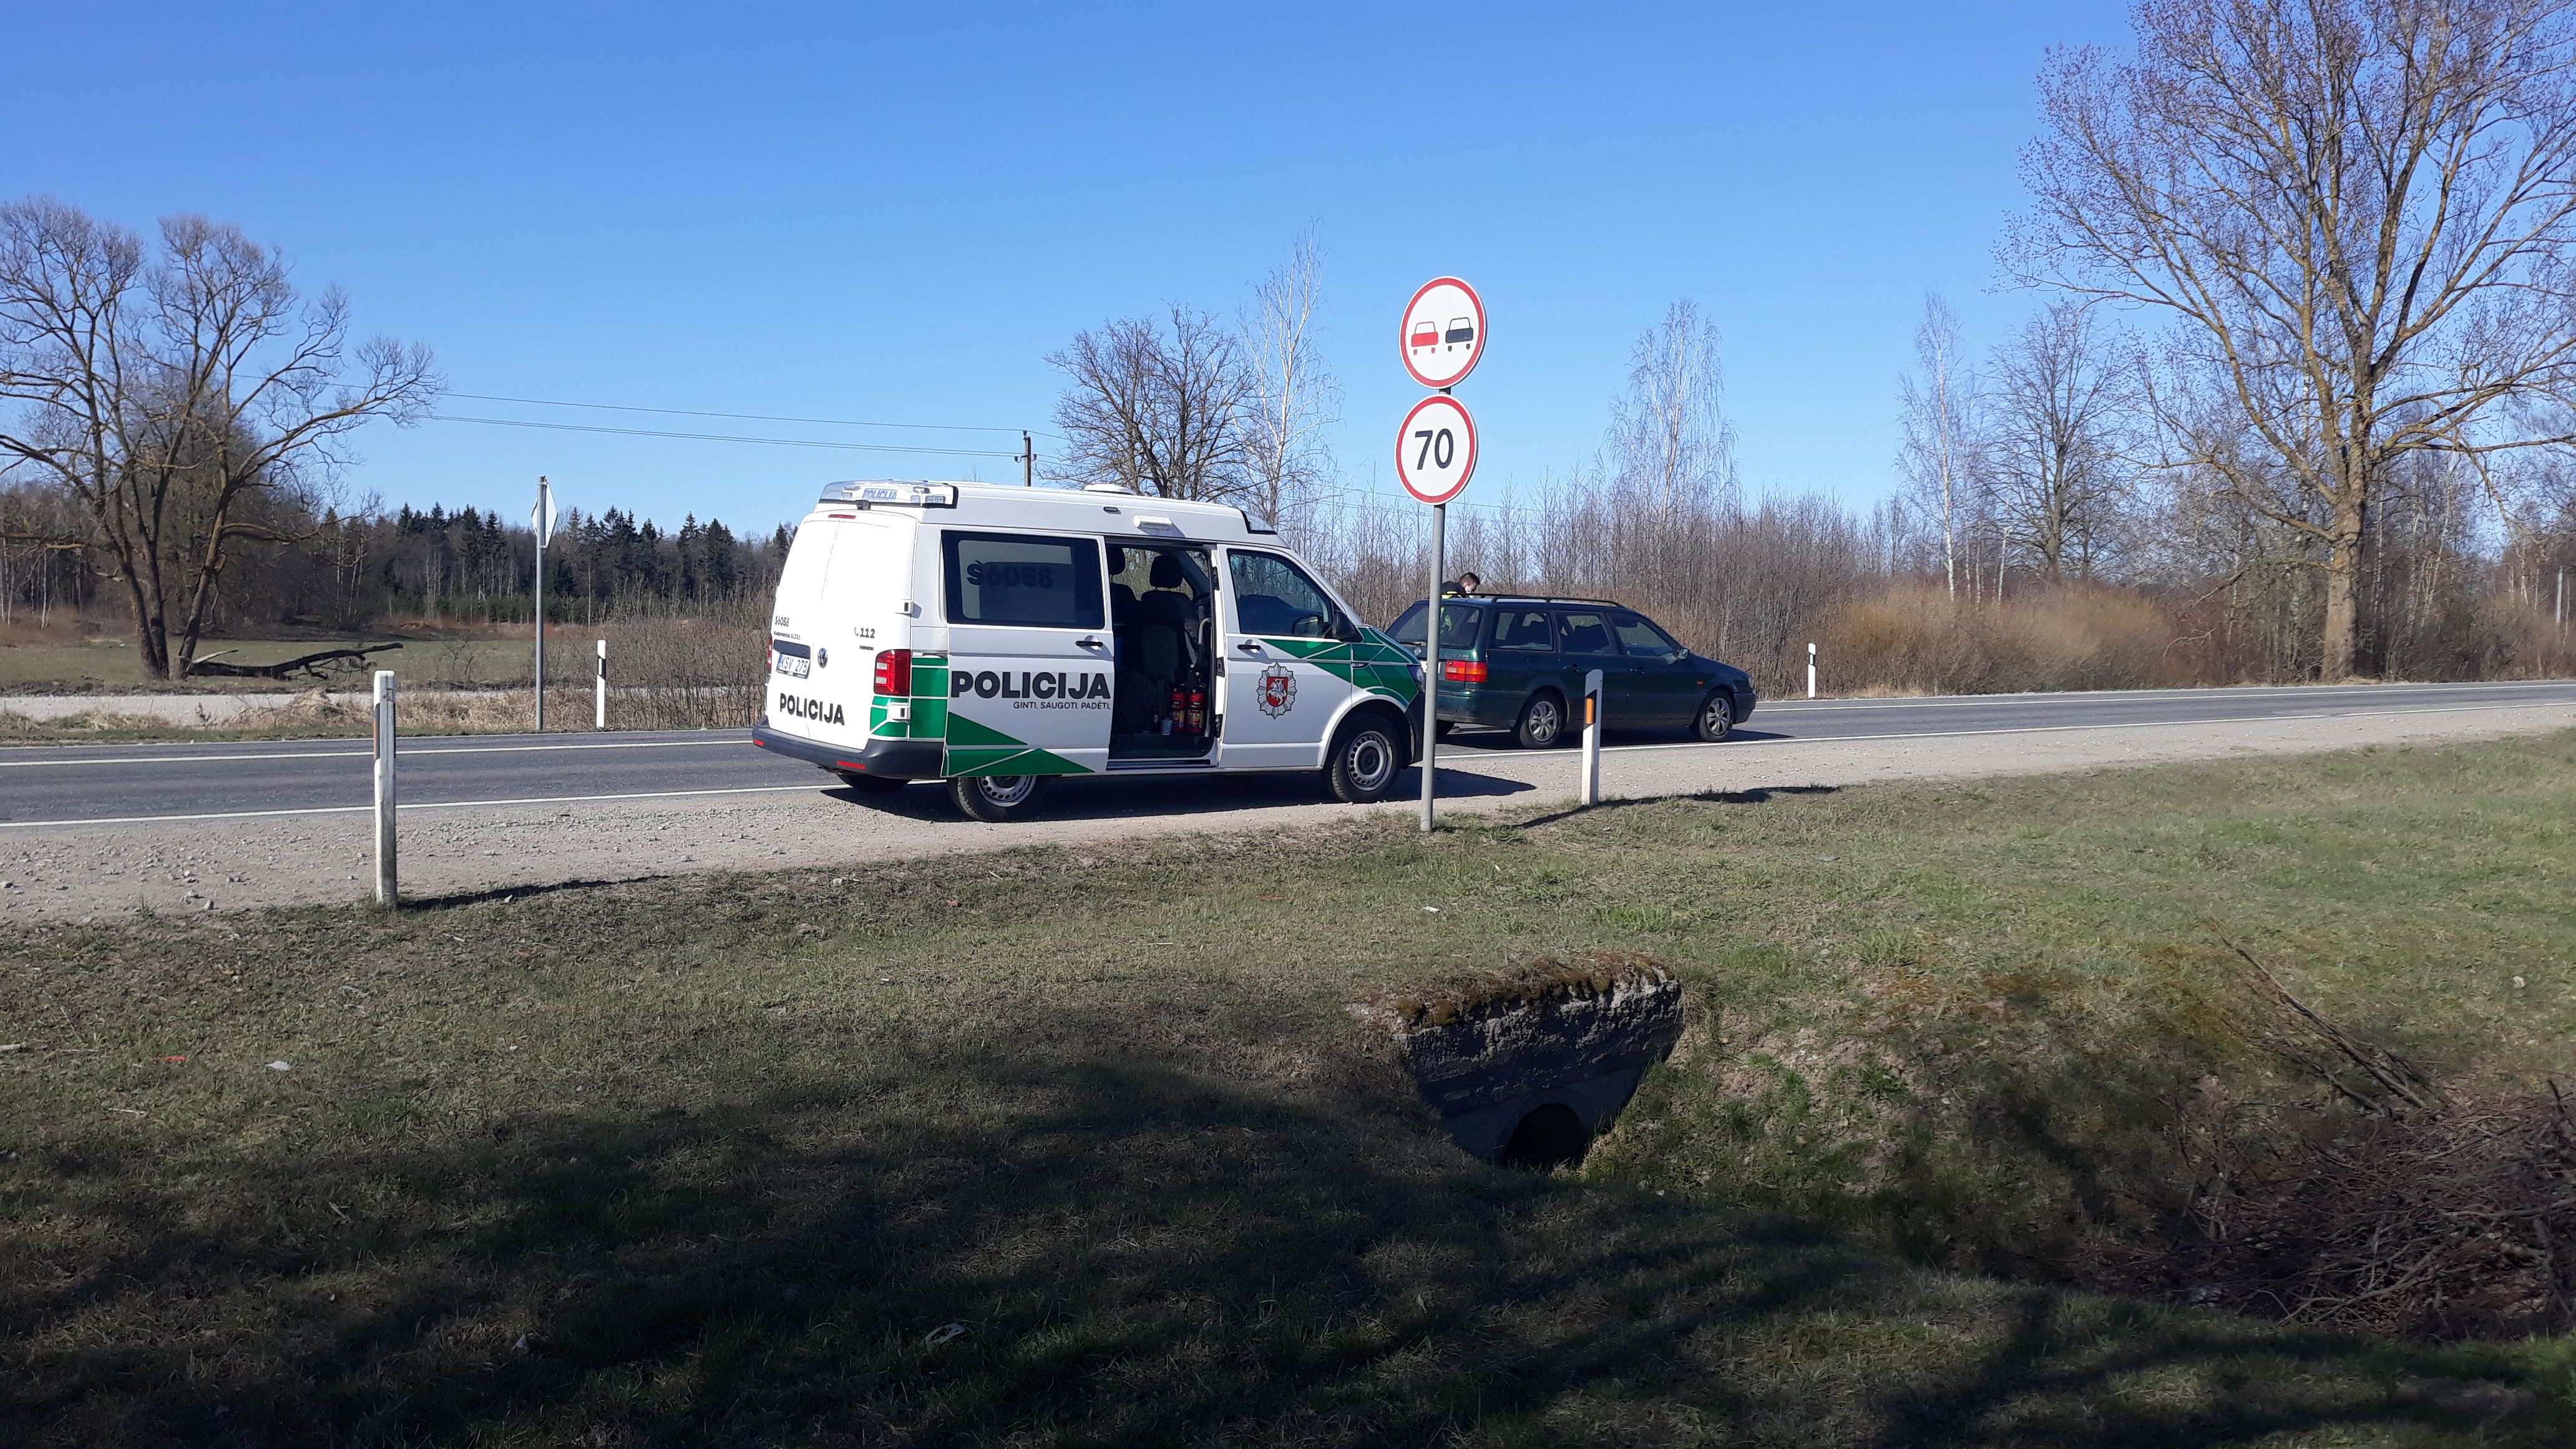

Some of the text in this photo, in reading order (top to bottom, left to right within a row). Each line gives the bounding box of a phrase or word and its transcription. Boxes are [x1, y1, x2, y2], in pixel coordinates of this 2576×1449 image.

[1415, 428, 1454, 470] 70
[860, 628, 875, 638] 112
[781, 656, 809, 673] KSV 275
[950, 671, 1111, 699] POLICIJA
[780, 693, 845, 726] POLICIJA
